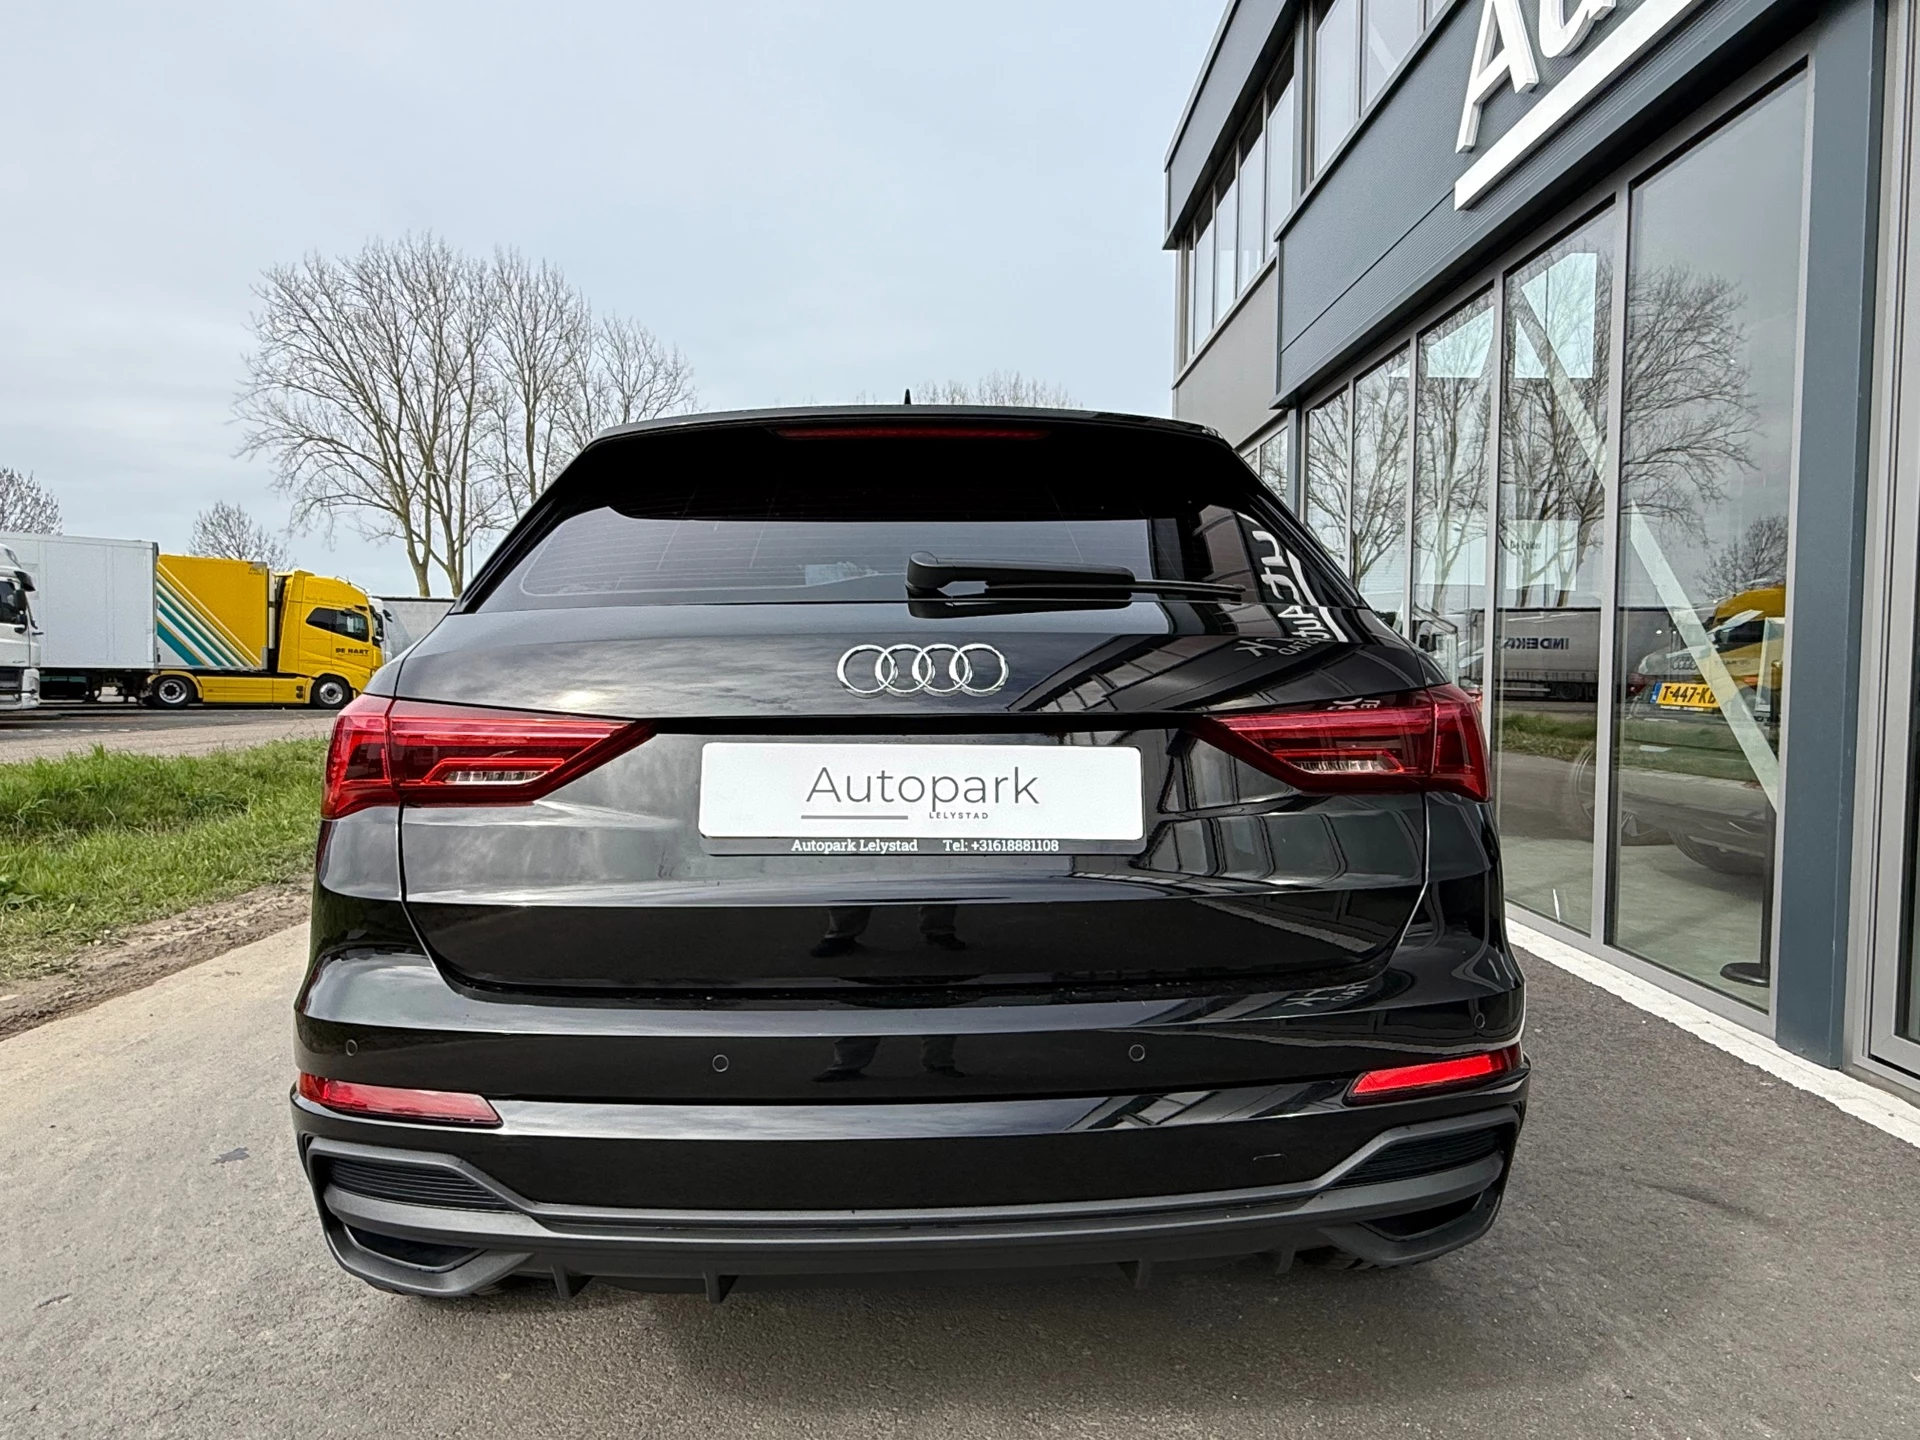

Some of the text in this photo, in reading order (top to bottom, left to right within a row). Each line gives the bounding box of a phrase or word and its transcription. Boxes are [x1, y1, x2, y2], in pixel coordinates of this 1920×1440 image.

[347, 647, 370, 655] HART
[805, 766, 1040, 813] Autopark
[929, 811, 989, 820] LELYSTAD
[791, 839, 1060, 854] Autopark Lelystad Tel: +31618881108
